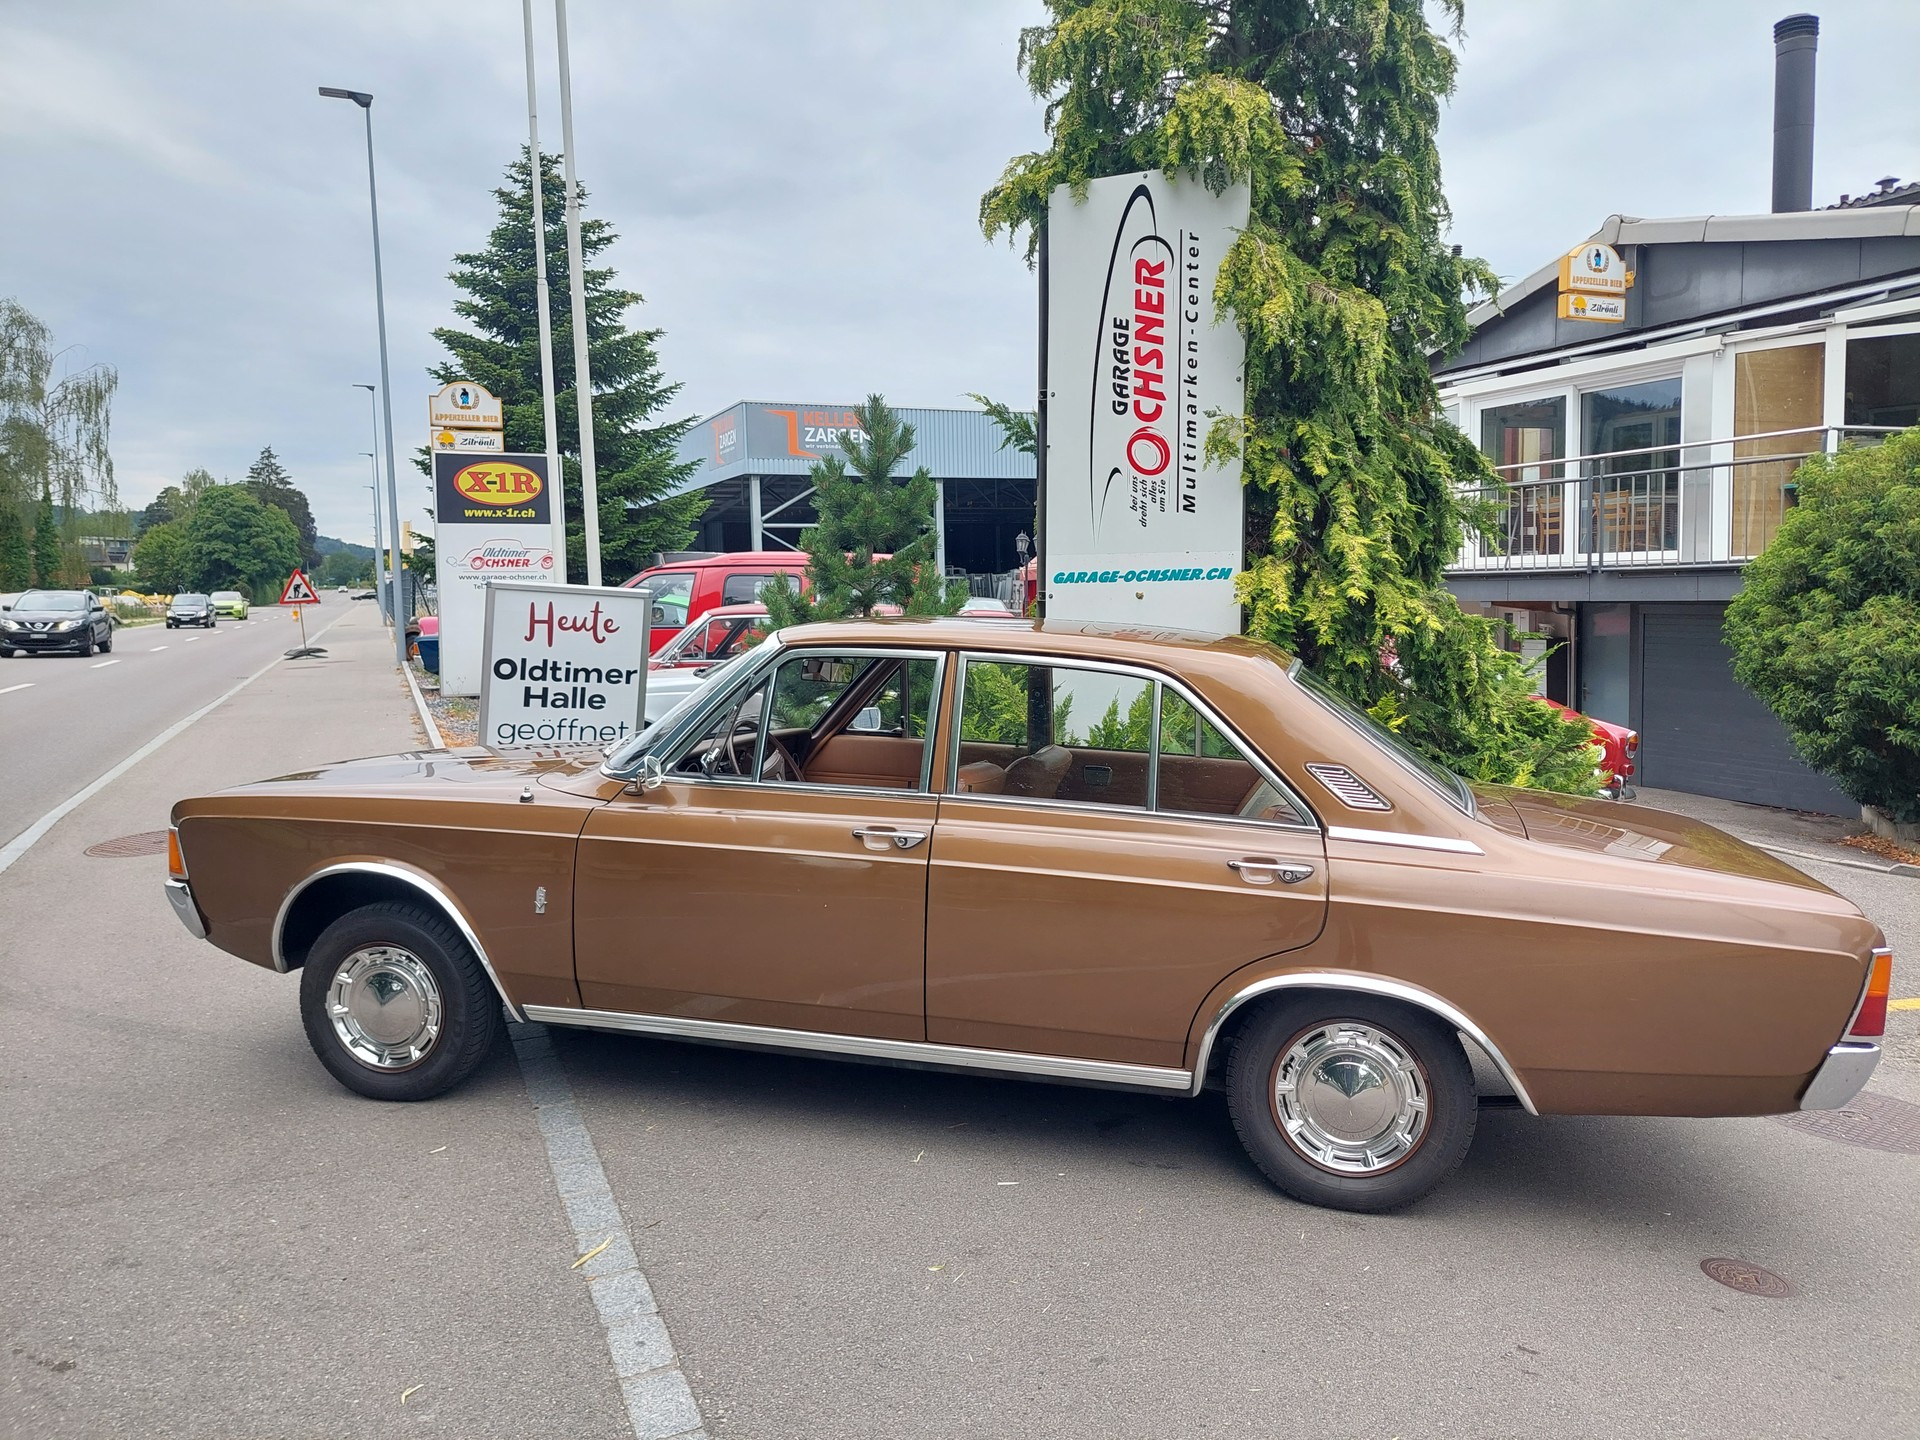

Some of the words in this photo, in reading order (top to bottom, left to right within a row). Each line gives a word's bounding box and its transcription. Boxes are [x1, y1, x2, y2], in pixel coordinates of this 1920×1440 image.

[1609, 279, 1622, 288] BIER
[1590, 303, 1618, 314] Zitrönli
[1112, 317, 1130, 416] GARAGE
[1127, 257, 1170, 476] OCHSNER
[1182, 231, 1199, 514] Multimarken-Center
[482, 415, 498, 423] BIER
[460, 437, 496, 446] Zitrönli
[465, 472, 537, 494] X-1R
[1139, 479, 1147, 498] sich
[1148, 480, 1157, 504] alles
[1158, 479, 1166, 495] Sie
[464, 507, 536, 518] www.x-1r.ch
[1130, 495, 1138, 512] bei
[1160, 497, 1166, 512] um
[1139, 500, 1147, 528] dreht
[482, 547, 531, 558] Oldtimer
[470, 556, 530, 570] OCHSNER
[1053, 567, 1233, 584] GARAGE-OCHSNER.CH
[524, 601, 620, 648] Heute
[493, 657, 638, 685] Oldtimer
[523, 686, 606, 710] Halle
[497, 718, 629, 745] geöffnet
